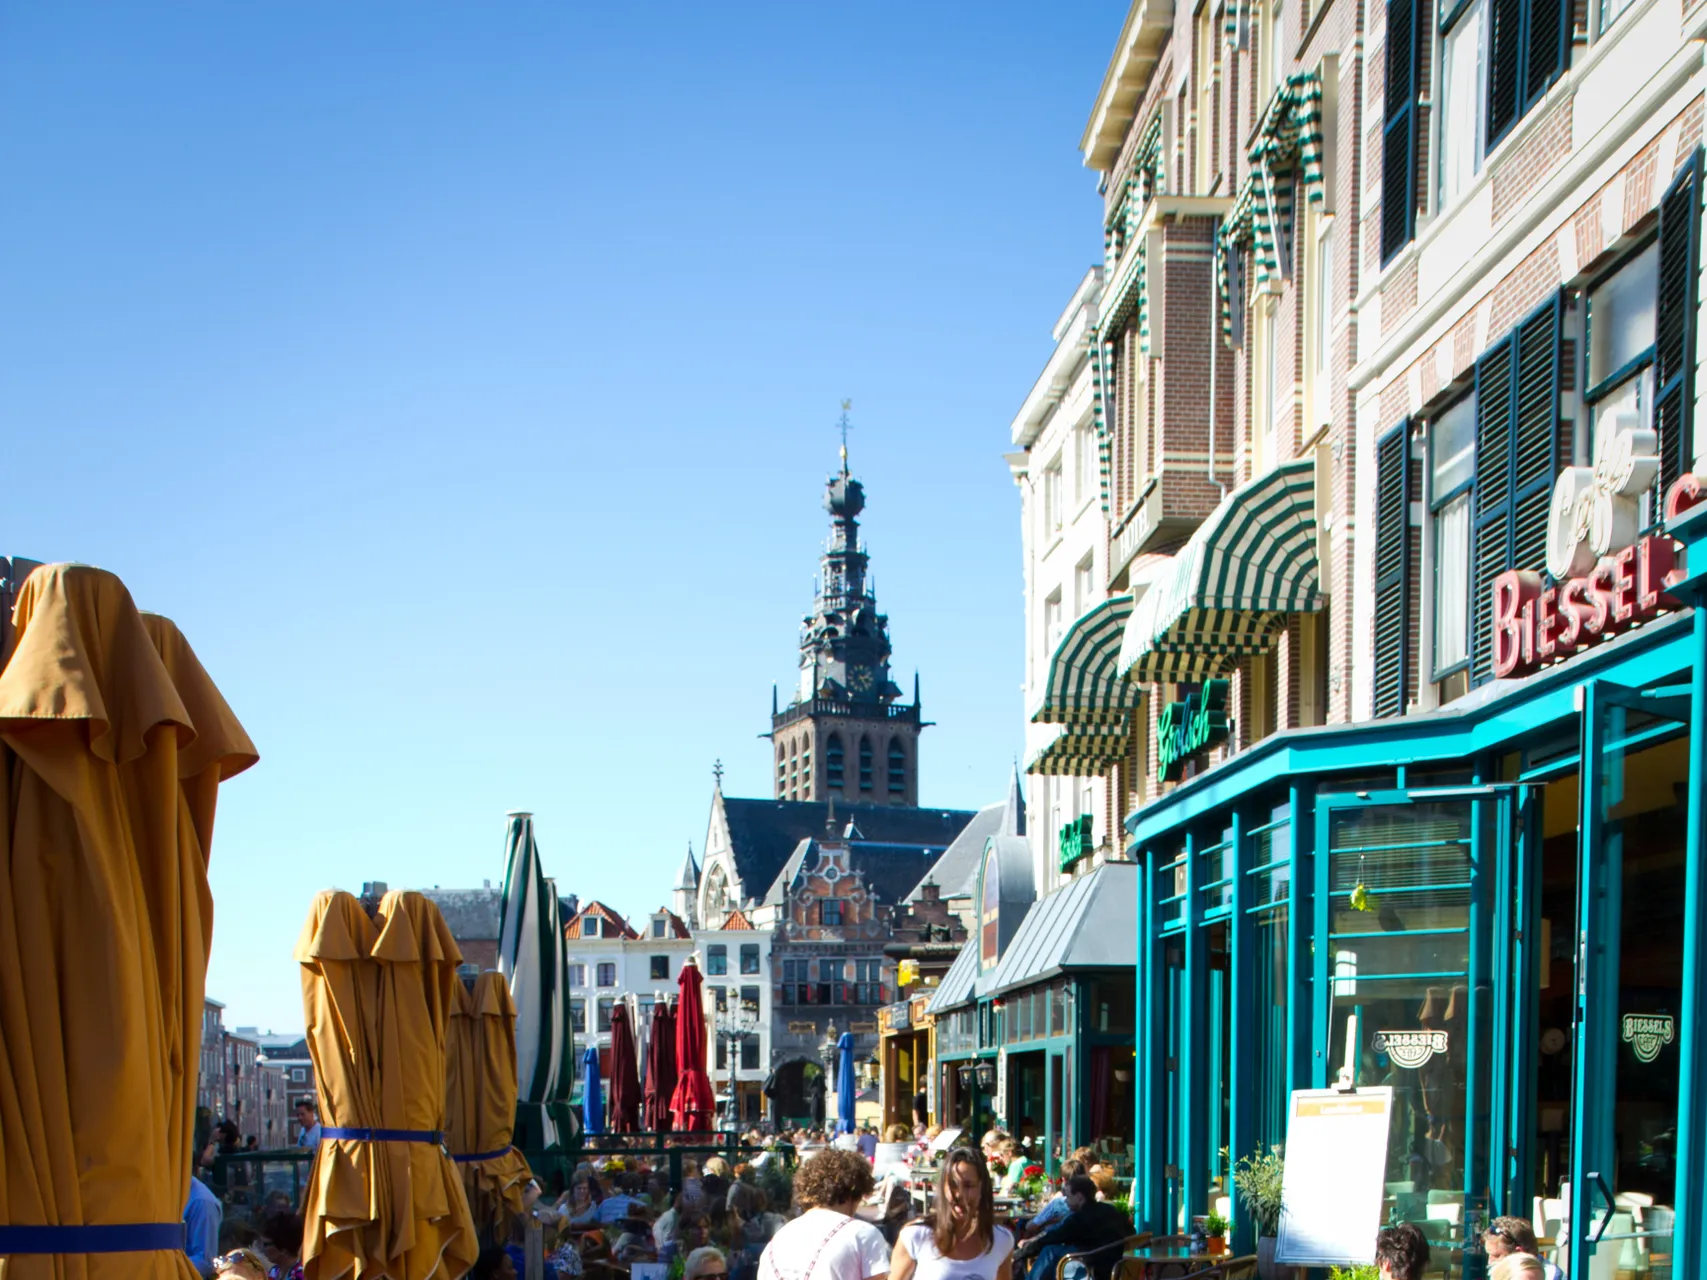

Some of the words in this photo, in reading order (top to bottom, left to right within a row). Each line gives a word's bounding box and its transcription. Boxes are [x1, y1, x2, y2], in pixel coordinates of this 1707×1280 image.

[1119, 502, 1150, 563] HOTEL
[1157, 679, 1210, 782] Grolsch
[1625, 1018, 1671, 1040] BIESSELS
